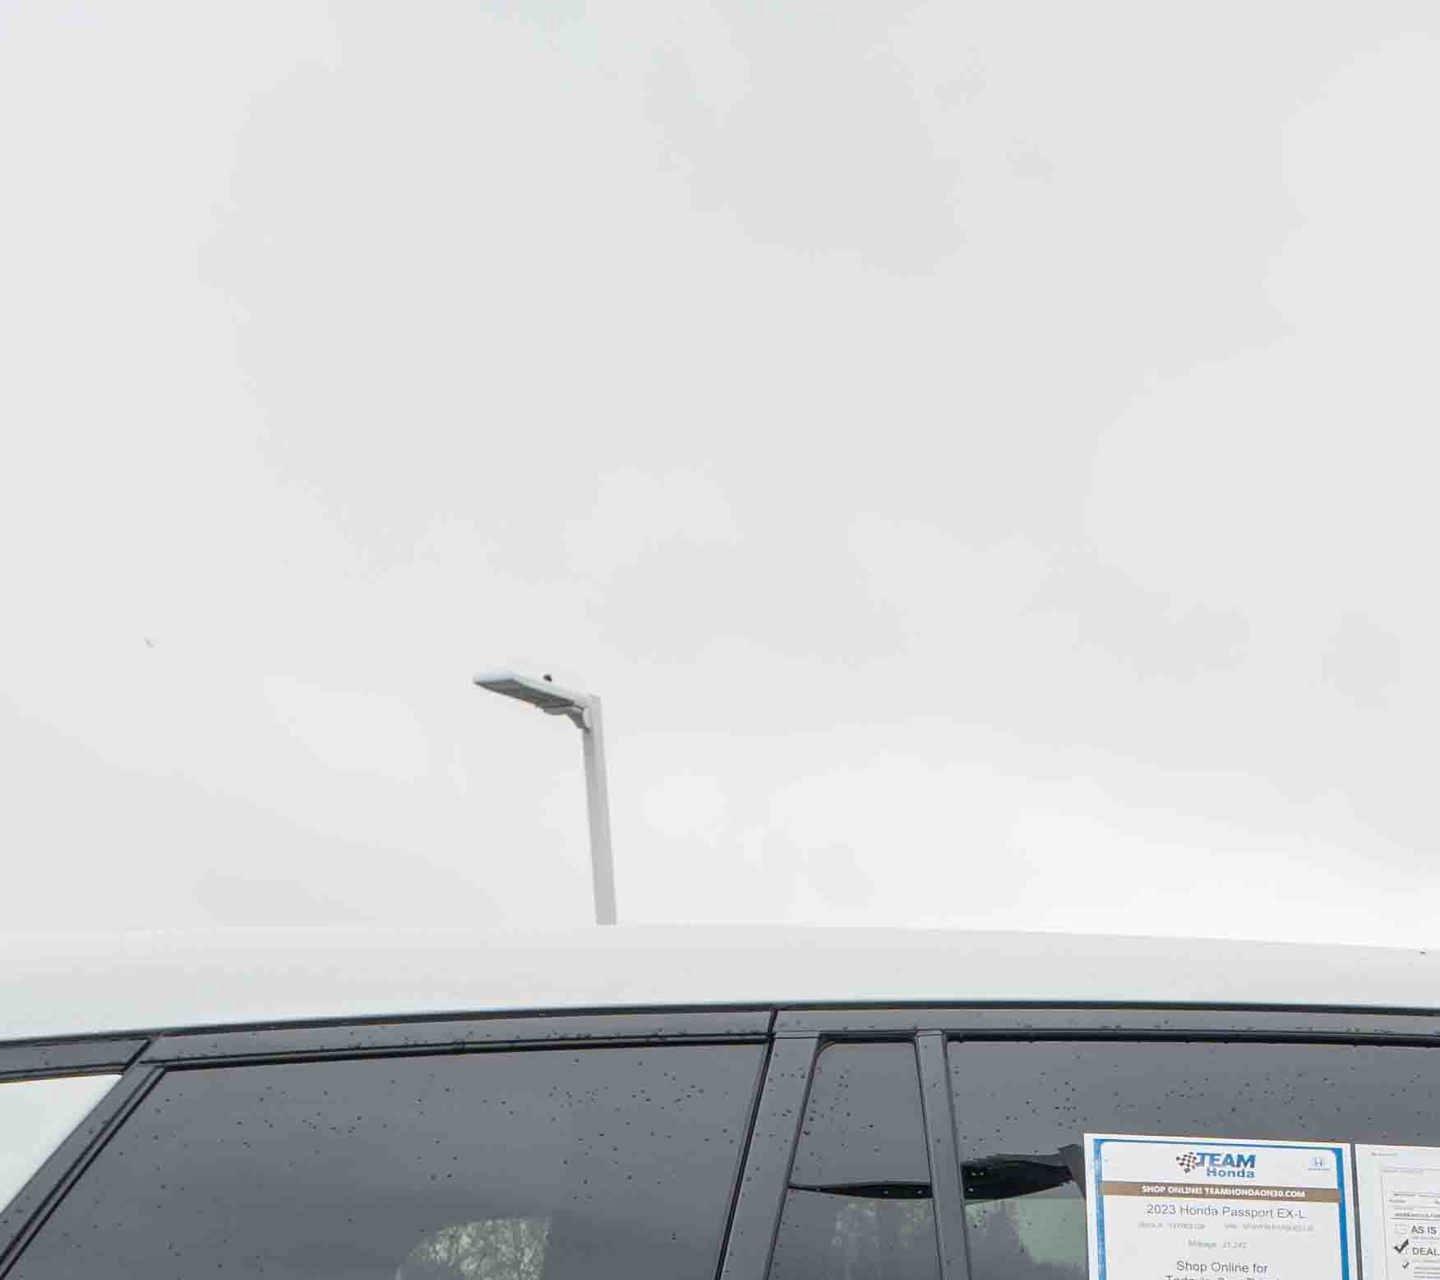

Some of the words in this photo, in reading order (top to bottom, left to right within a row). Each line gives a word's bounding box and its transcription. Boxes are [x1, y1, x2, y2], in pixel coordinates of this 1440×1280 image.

[1197, 1152, 1256, 1168] TEAM
[1207, 1167, 1255, 1179] Honda
[1142, 1185, 1166, 1193] SHOP
[1146, 1204, 1177, 1215] 2023
[1180, 1205, 1218, 1216] Honda
[1222, 1206, 1273, 1219] Passport
[1277, 1208, 1306, 1219] EX-L
[1411, 1225, 1425, 1234] AS
[1427, 1226, 1437, 1235] IS
[1176, 1260, 1208, 1273] Shop
[1211, 1262, 1250, 1274] Online
[1252, 1262, 1269, 1274] for
